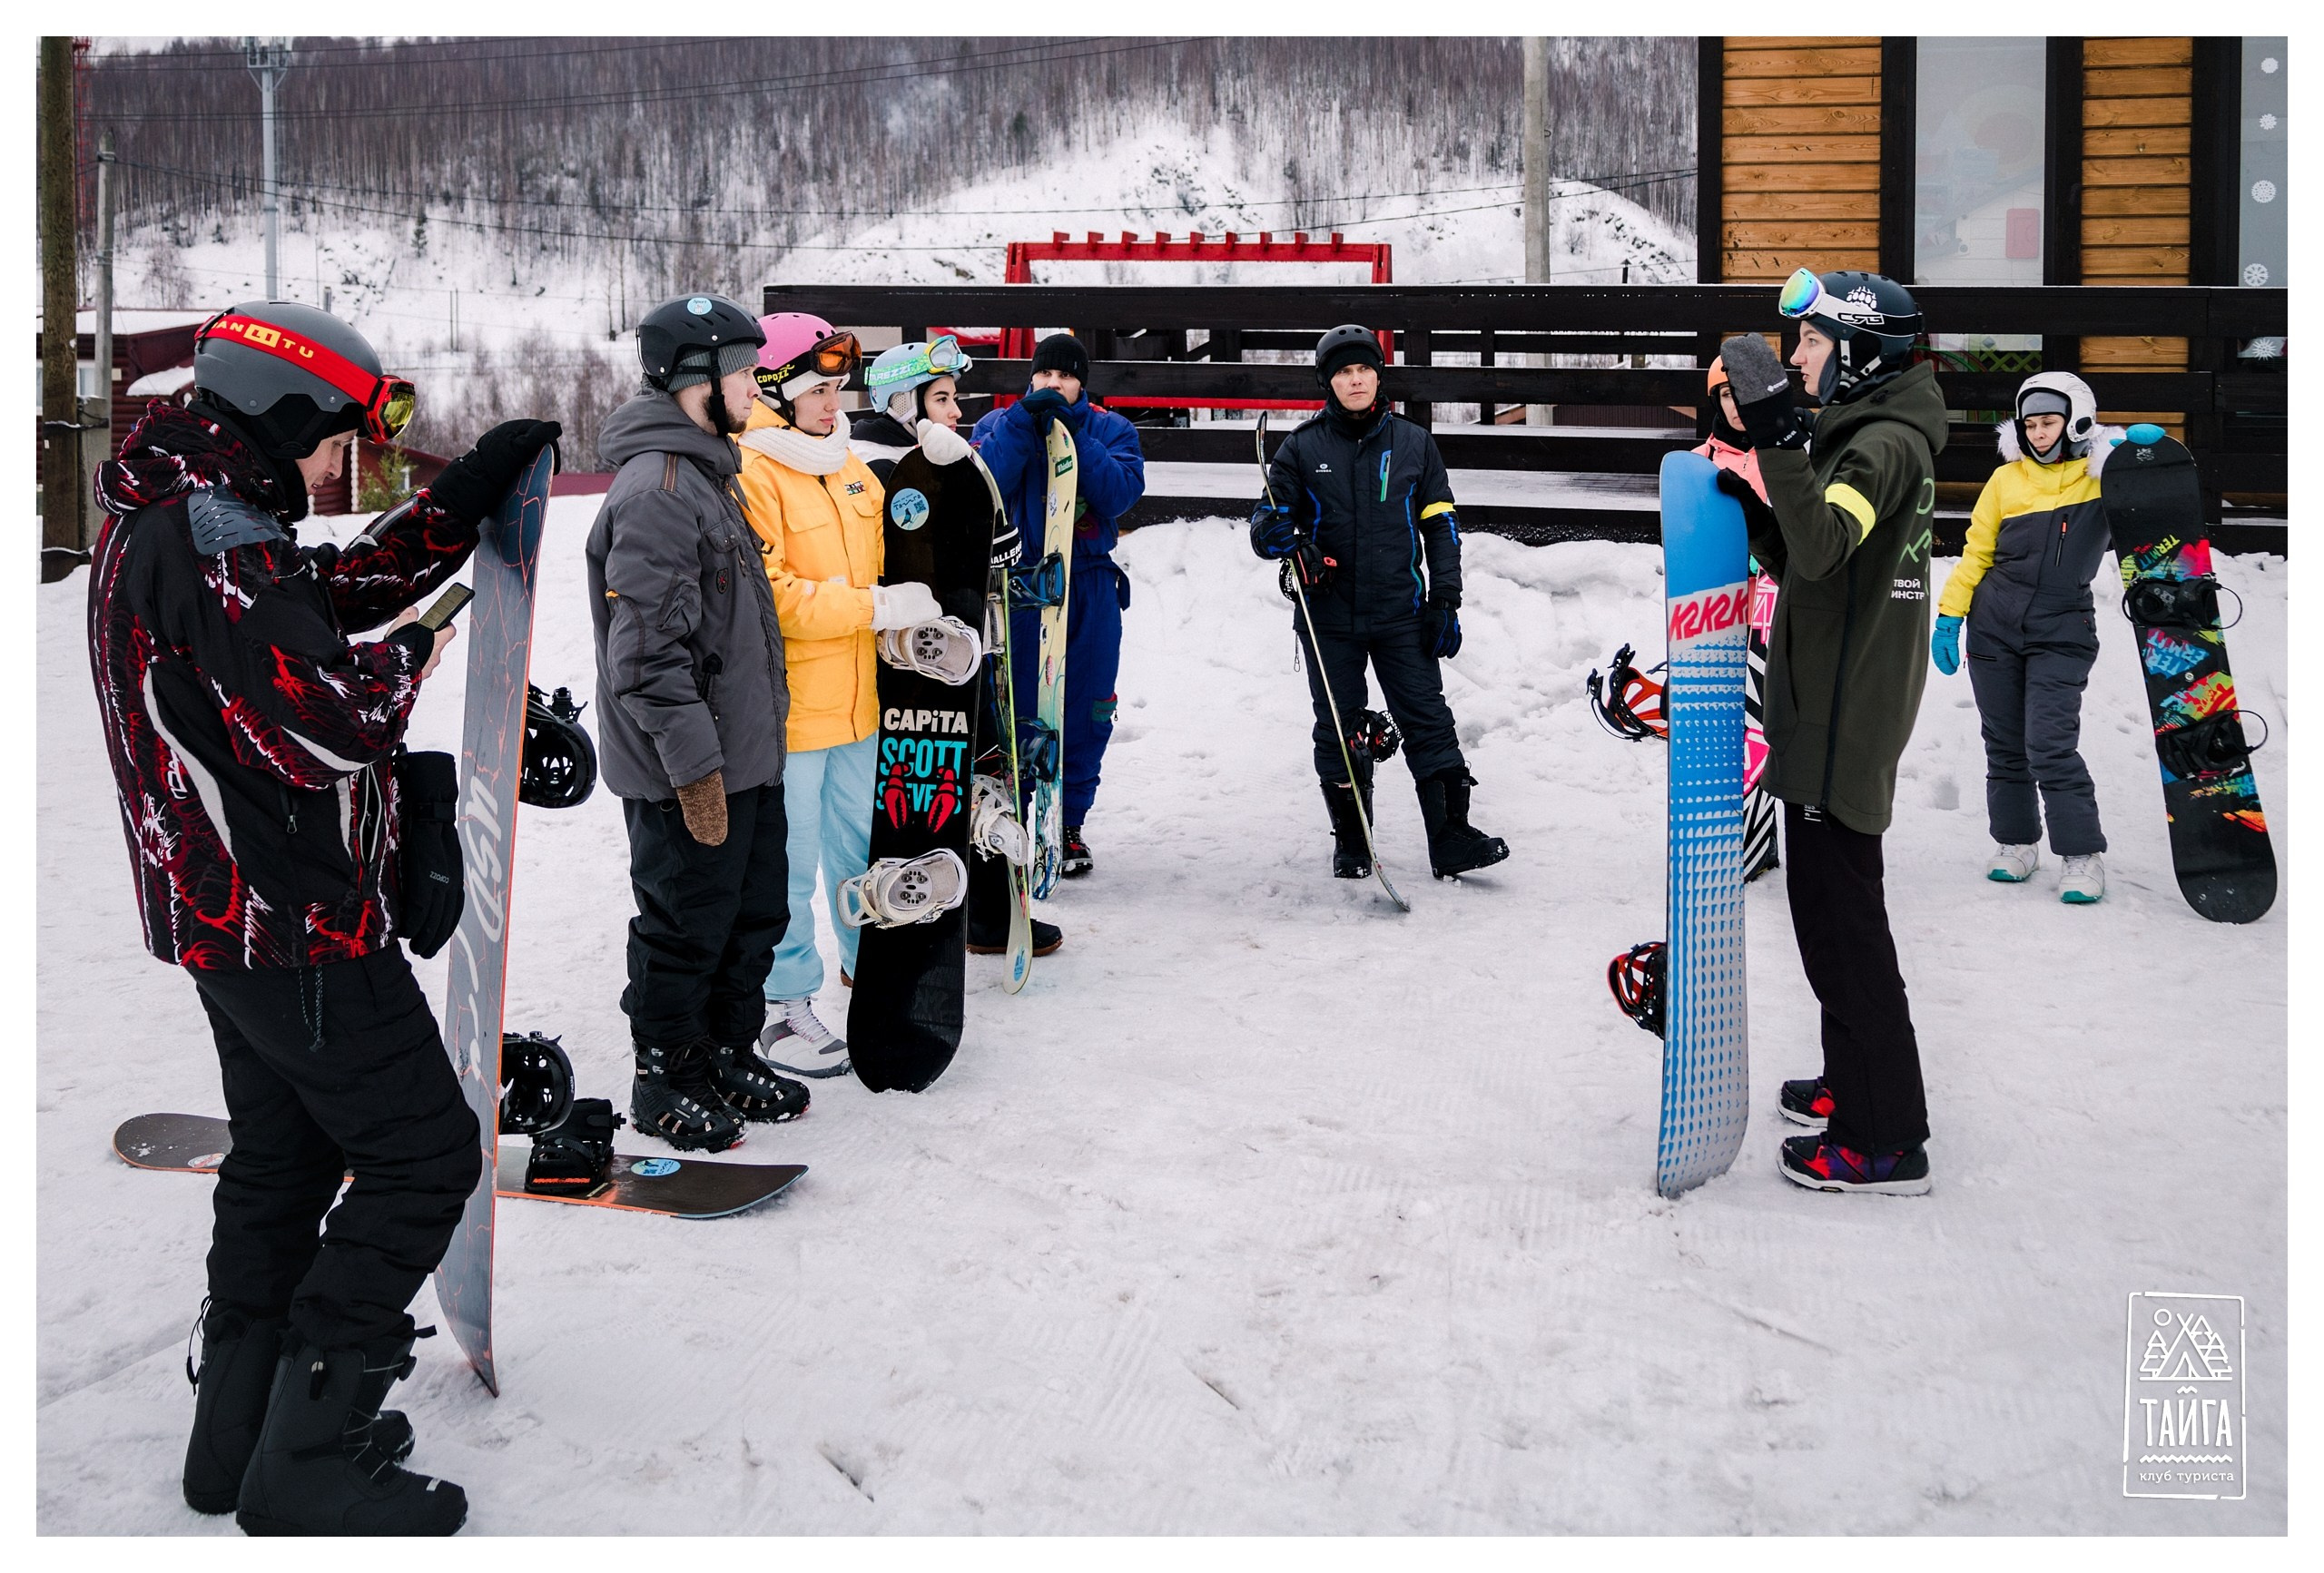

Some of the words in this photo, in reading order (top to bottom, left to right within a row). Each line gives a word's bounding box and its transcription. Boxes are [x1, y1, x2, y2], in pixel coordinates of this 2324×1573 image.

[211, 321, 314, 359] ANLITU
[1893, 578, 1921, 589] ТВОЙ
[880, 737, 968, 779] SCOTT
